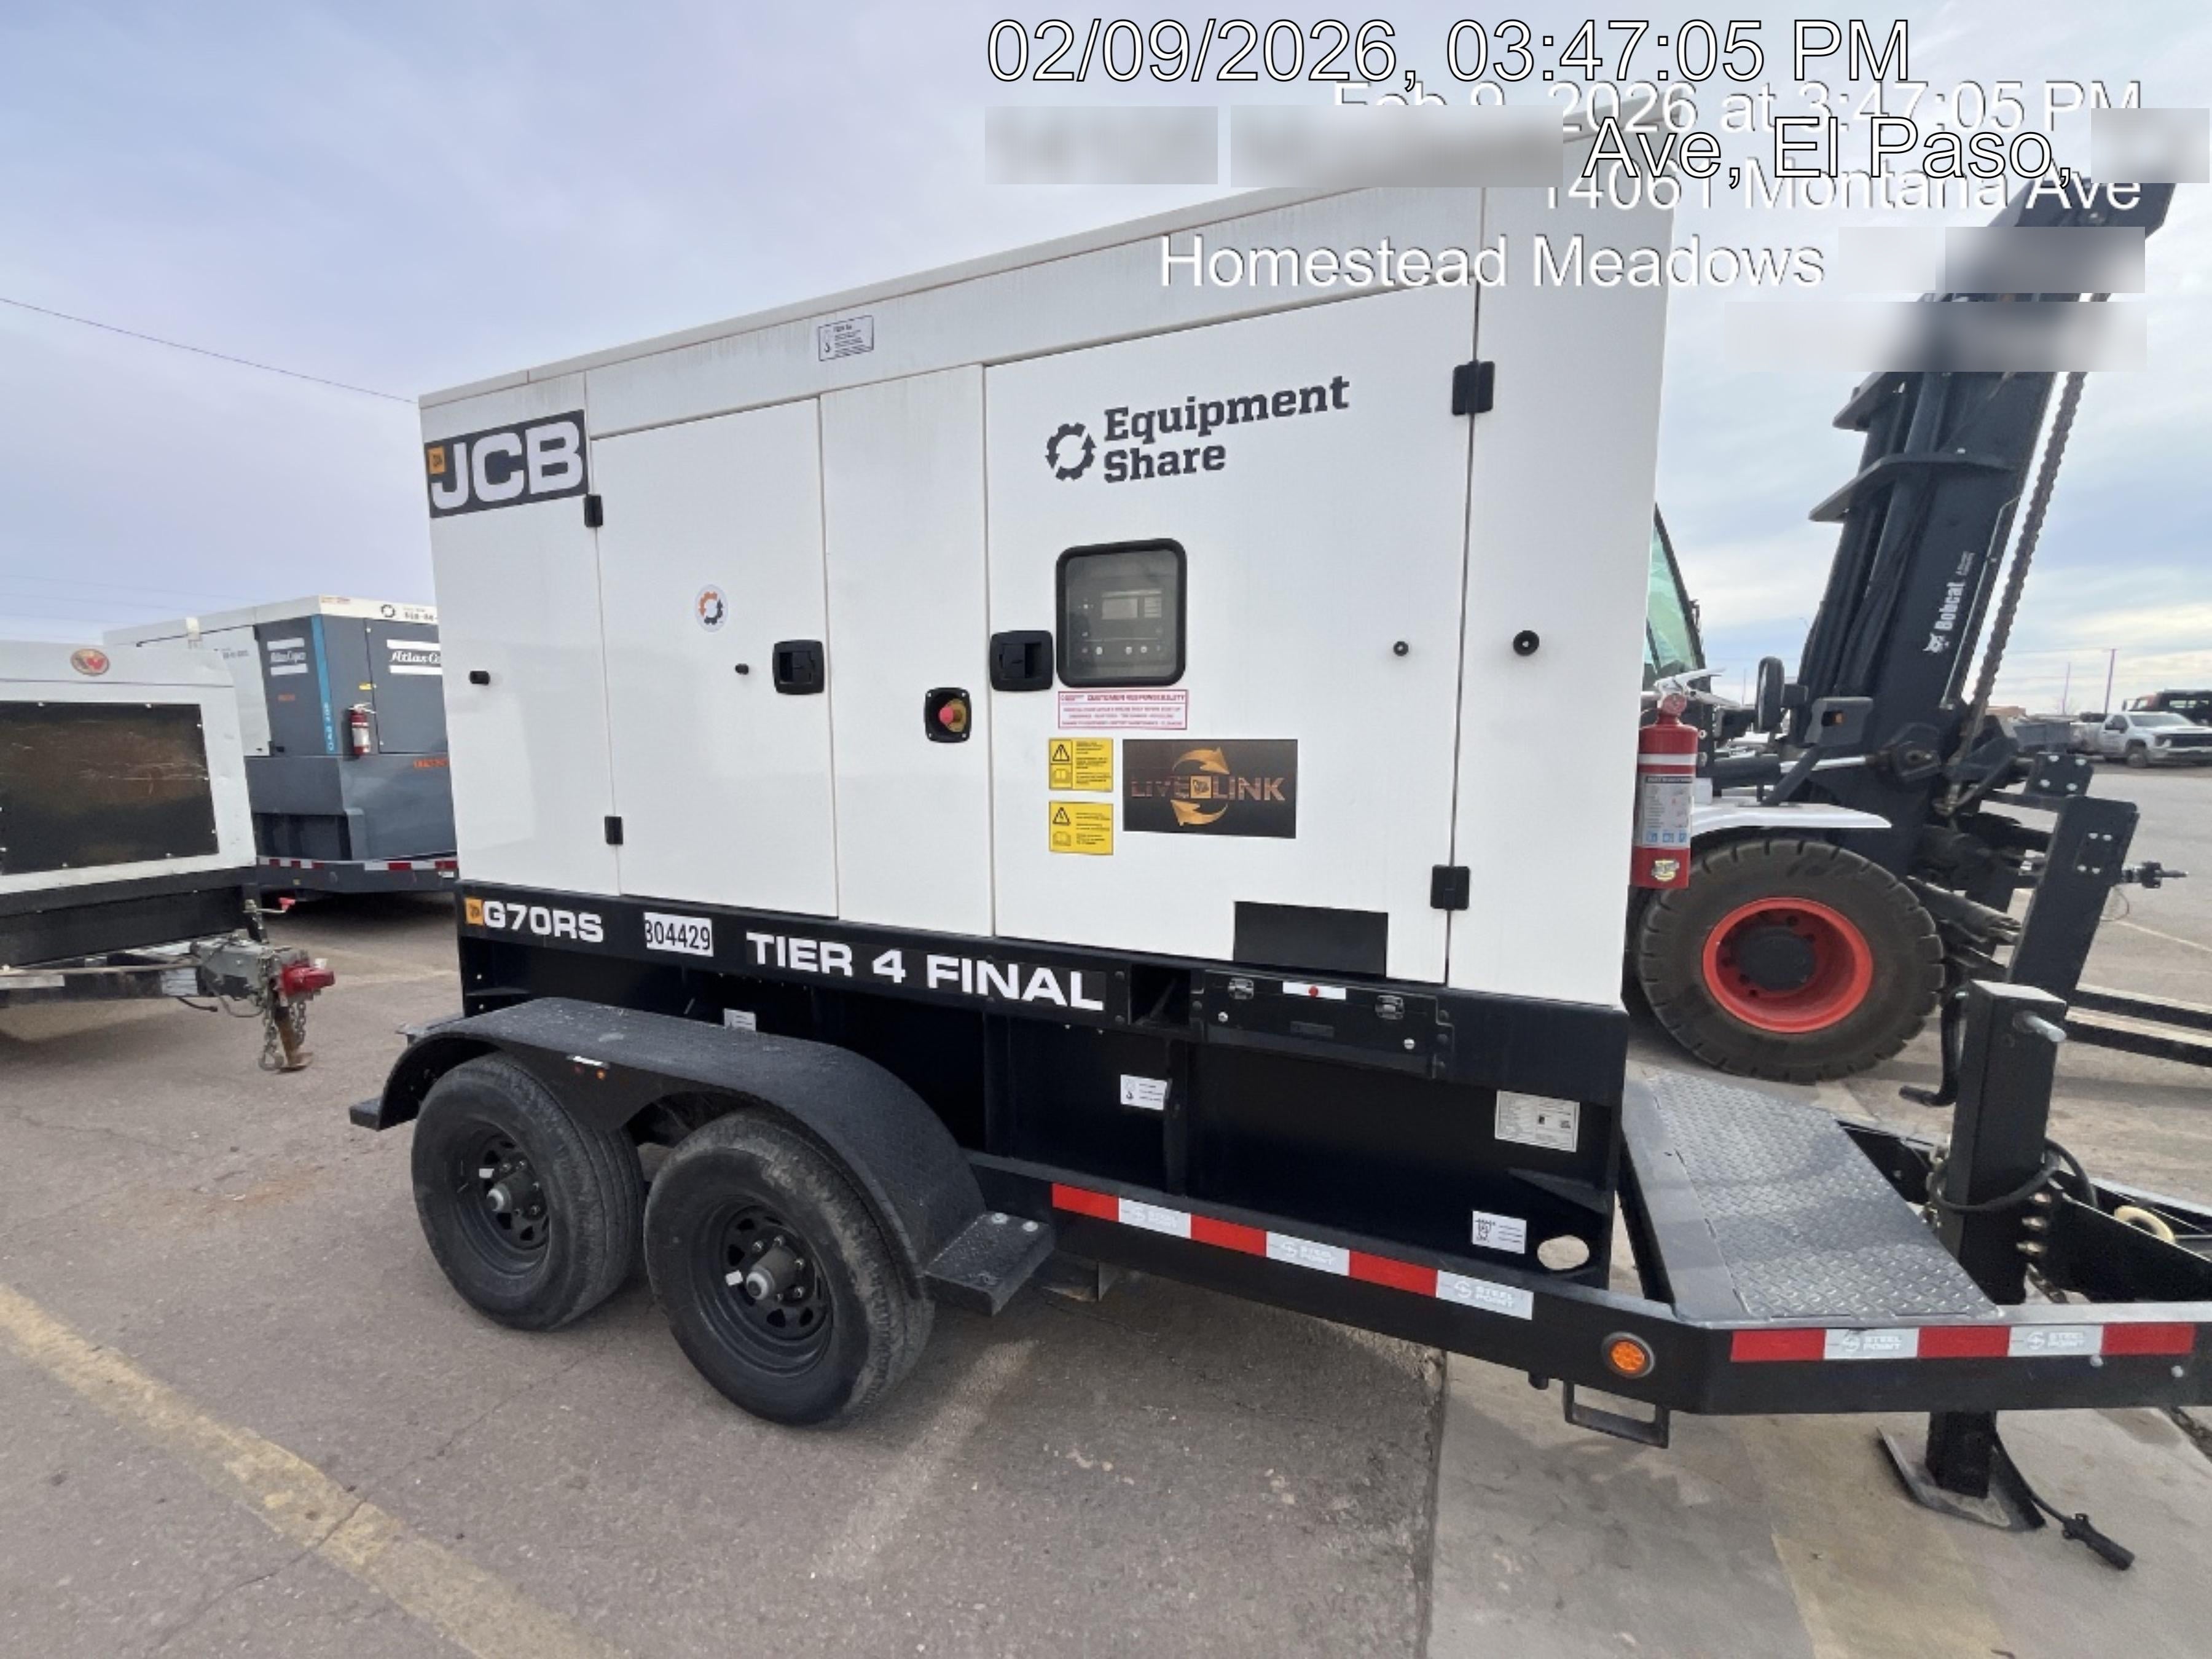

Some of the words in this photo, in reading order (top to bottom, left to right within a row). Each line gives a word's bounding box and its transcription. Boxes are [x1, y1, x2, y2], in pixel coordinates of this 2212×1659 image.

[1104, 375, 1350, 445] Equipment
[431, 421, 583, 509] JCB
[1104, 444, 1226, 484] Share
[1934, 579, 1966, 631] Bobcat
[1212, 775, 1286, 801] LINK
[483, 900, 604, 943] G70RS
[745, 931, 854, 978] TIER
[872, 949, 906, 983] 4
[927, 954, 1104, 1011] FINAL
